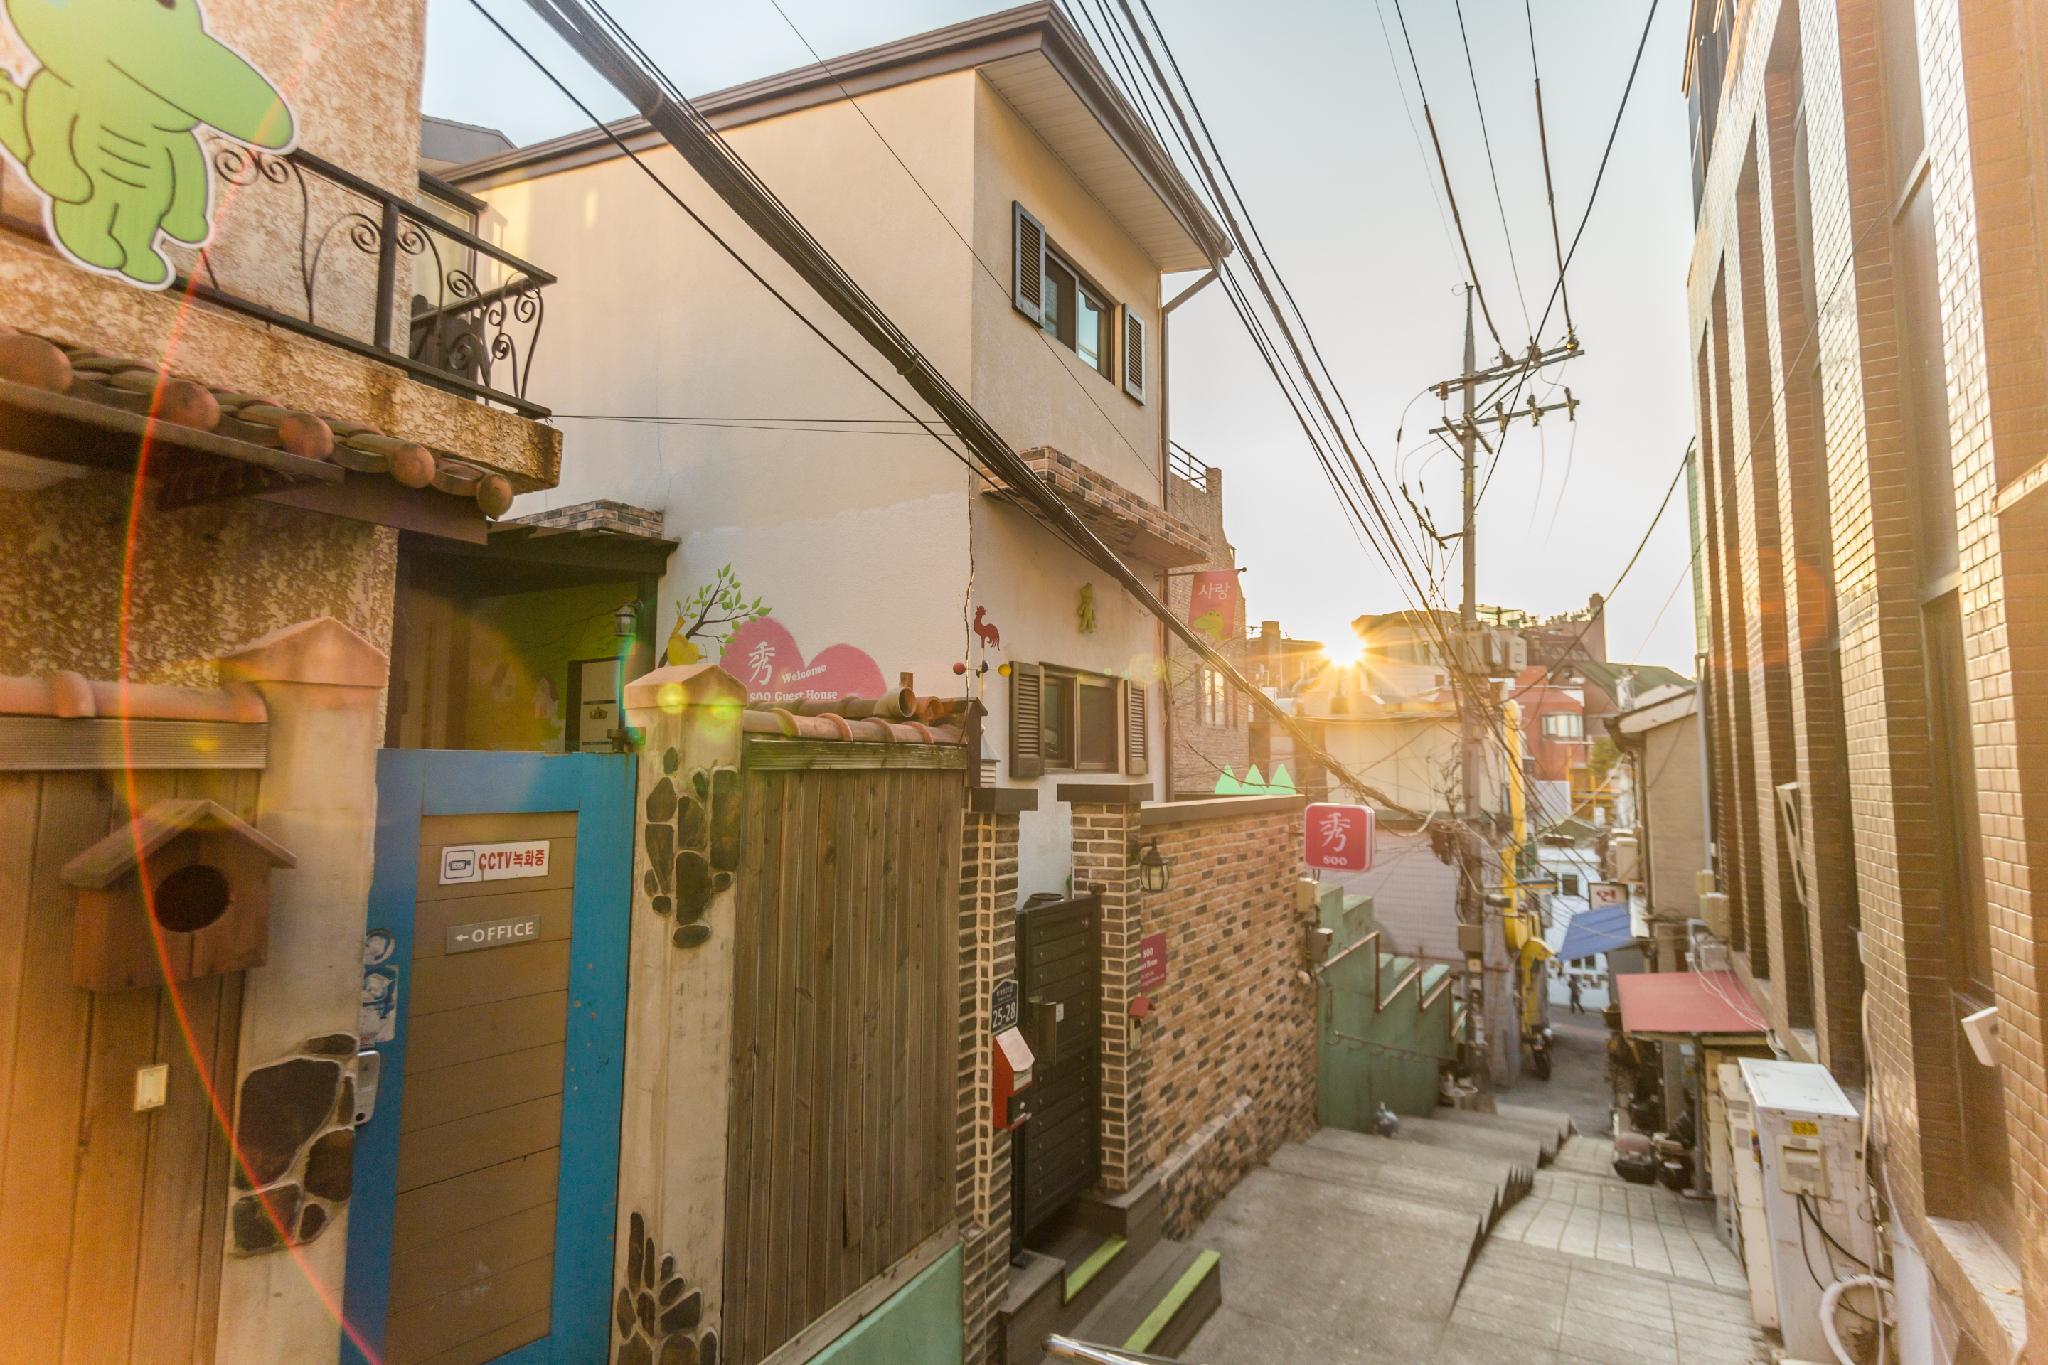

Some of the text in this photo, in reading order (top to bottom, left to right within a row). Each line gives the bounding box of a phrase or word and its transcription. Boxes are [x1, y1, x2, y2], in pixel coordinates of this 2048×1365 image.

[1197, 581, 1231, 600] 사랑
[748, 641, 776, 685] 秀
[782, 664, 828, 684] Welcome
[775, 690, 804, 702] Guest
[806, 689, 838, 700] House
[1318, 812, 1351, 852] 秀
[479, 850, 544, 870] CCTV녹화중
[1323, 855, 1348, 866] SOO
[472, 922, 533, 943] OFFICE
[993, 1002, 1015, 1028] 25-28
